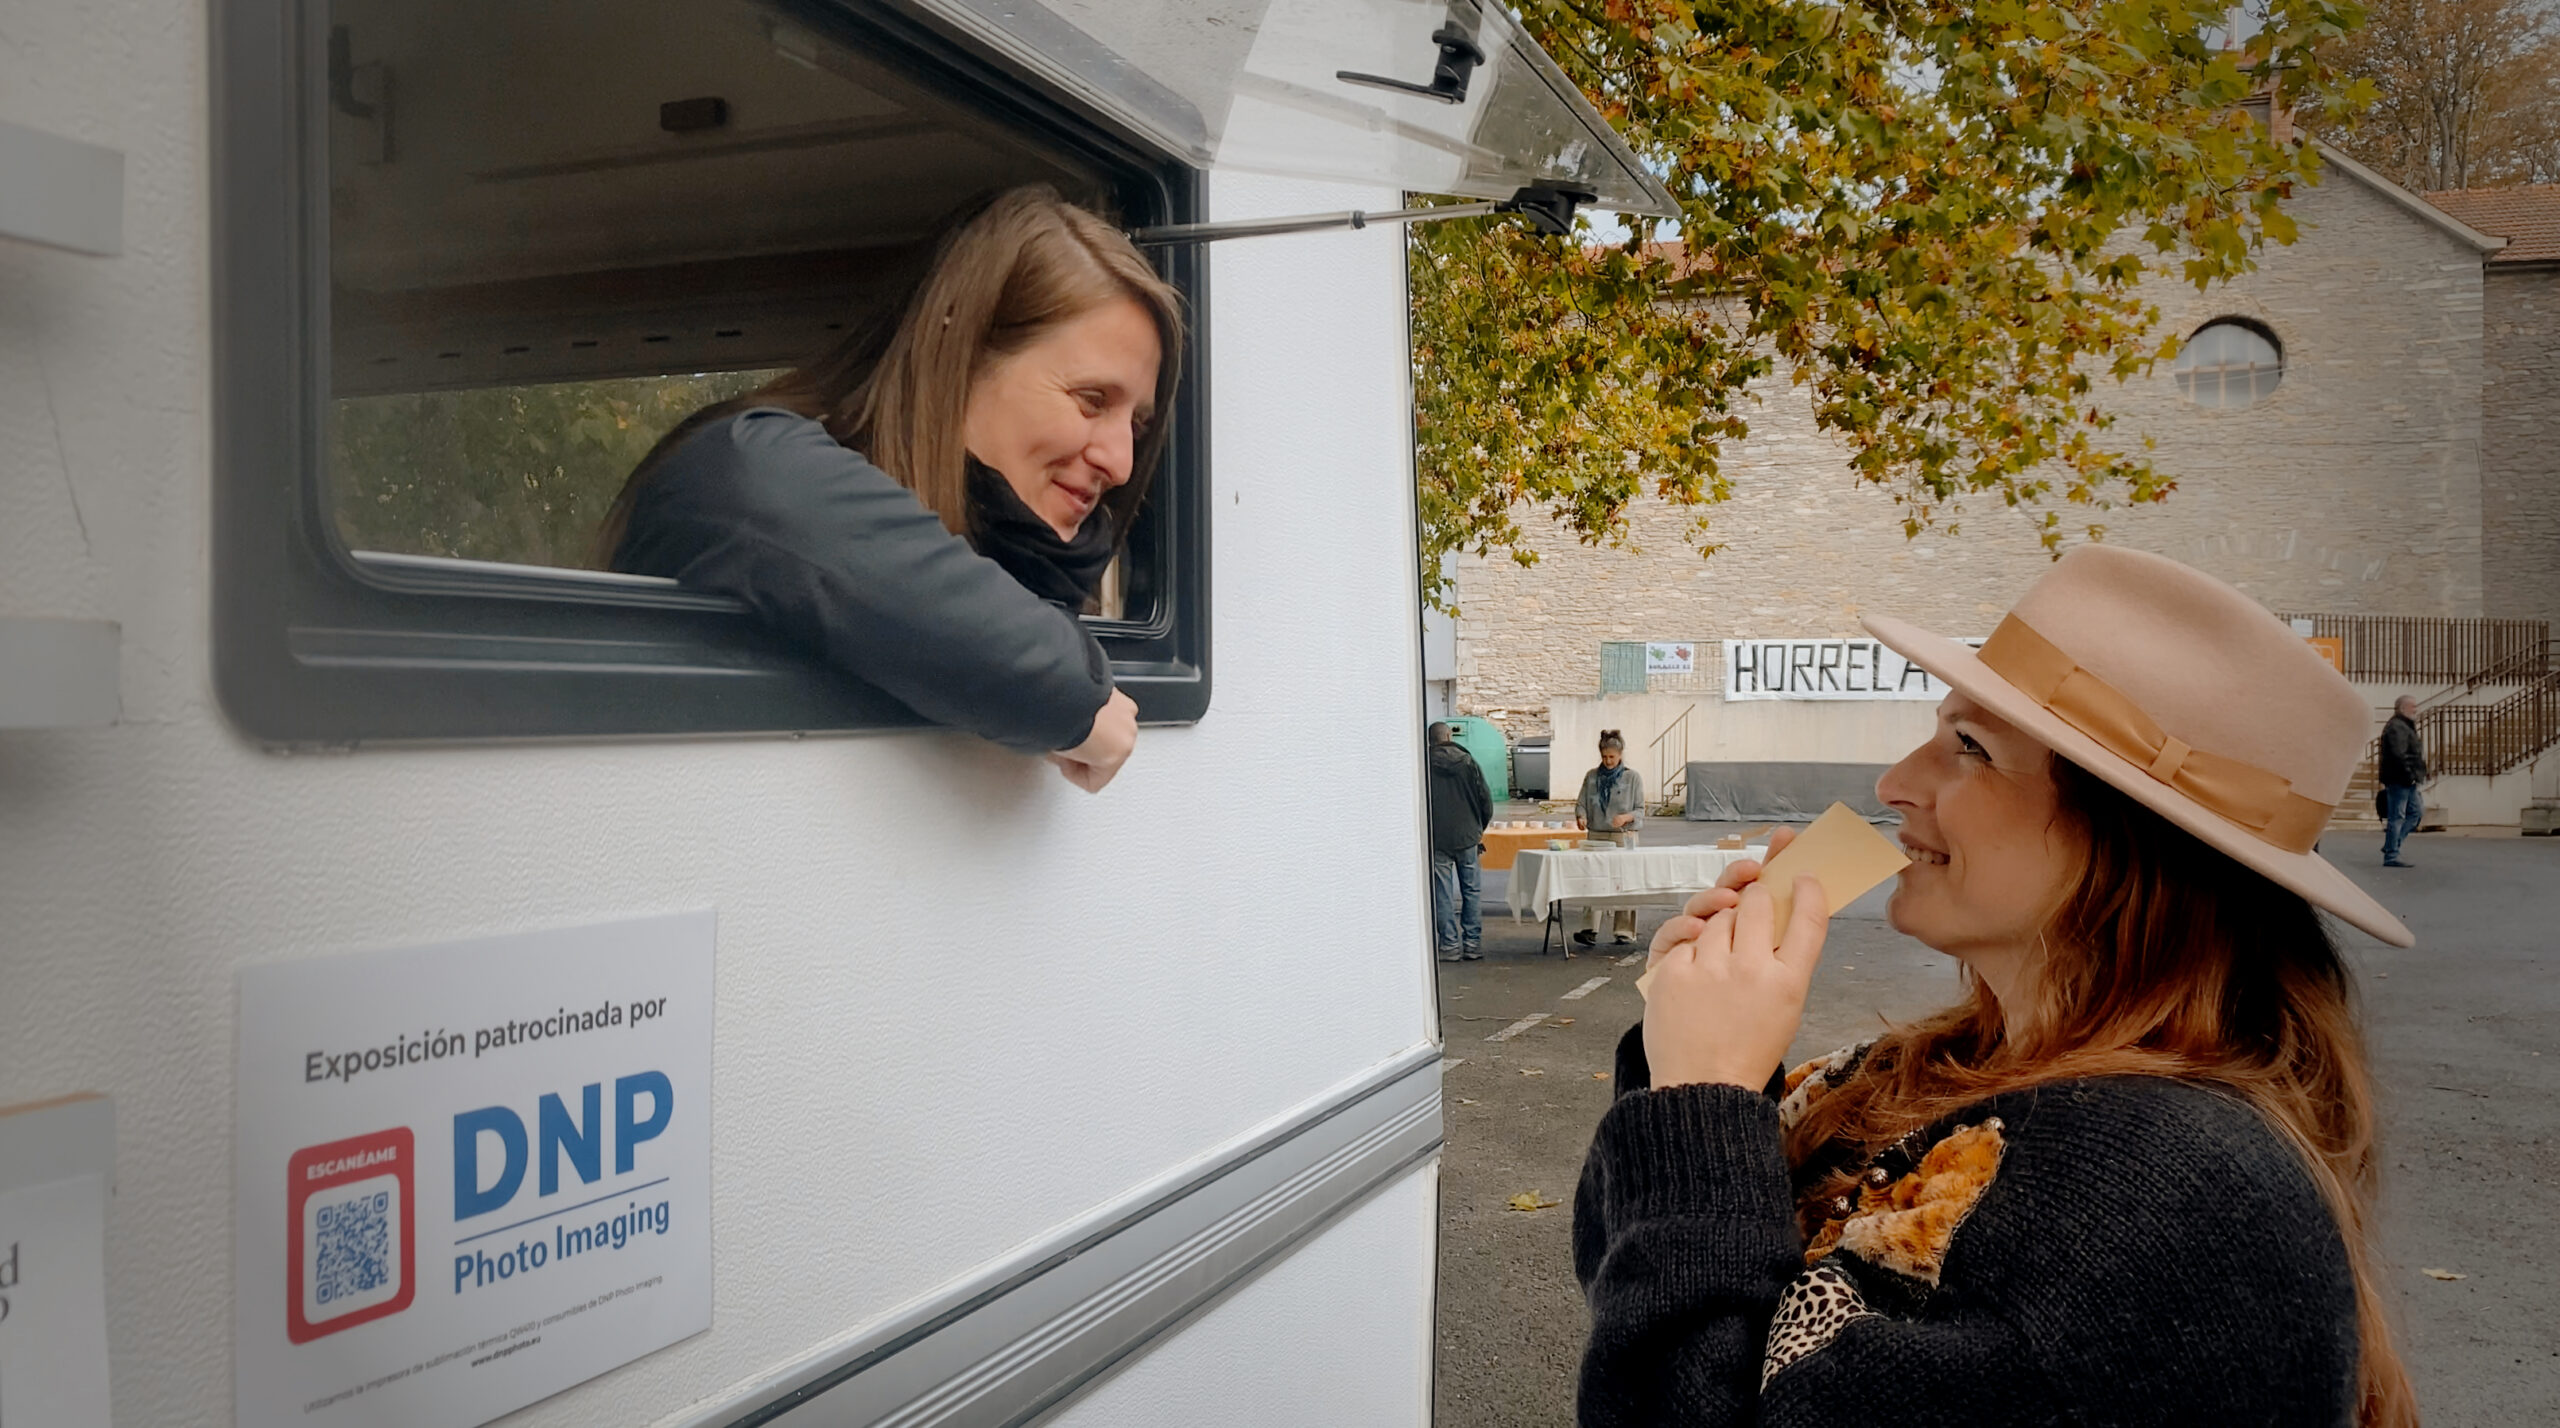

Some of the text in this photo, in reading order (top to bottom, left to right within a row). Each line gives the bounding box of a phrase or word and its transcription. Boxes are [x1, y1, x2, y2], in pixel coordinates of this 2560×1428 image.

[1735, 643, 1929, 692] HORRELA
[304, 997, 667, 1083] Exposición patrocinada por
[307, 1145, 397, 1180] ESCANÉAME
[454, 1070, 673, 1222] DNP
[455, 1200, 670, 1296] Photo Imaging
[412, 1363, 424, 1375] de
[543, 1302, 587, 1327] consumibles
[588, 1298, 598, 1310] de
[598, 1290, 614, 1306] DNP
[615, 1285, 635, 1299] Photo
[635, 1274, 663, 1292] Imaging
[470, 1335, 542, 1368] www.dnpphoto.eu
